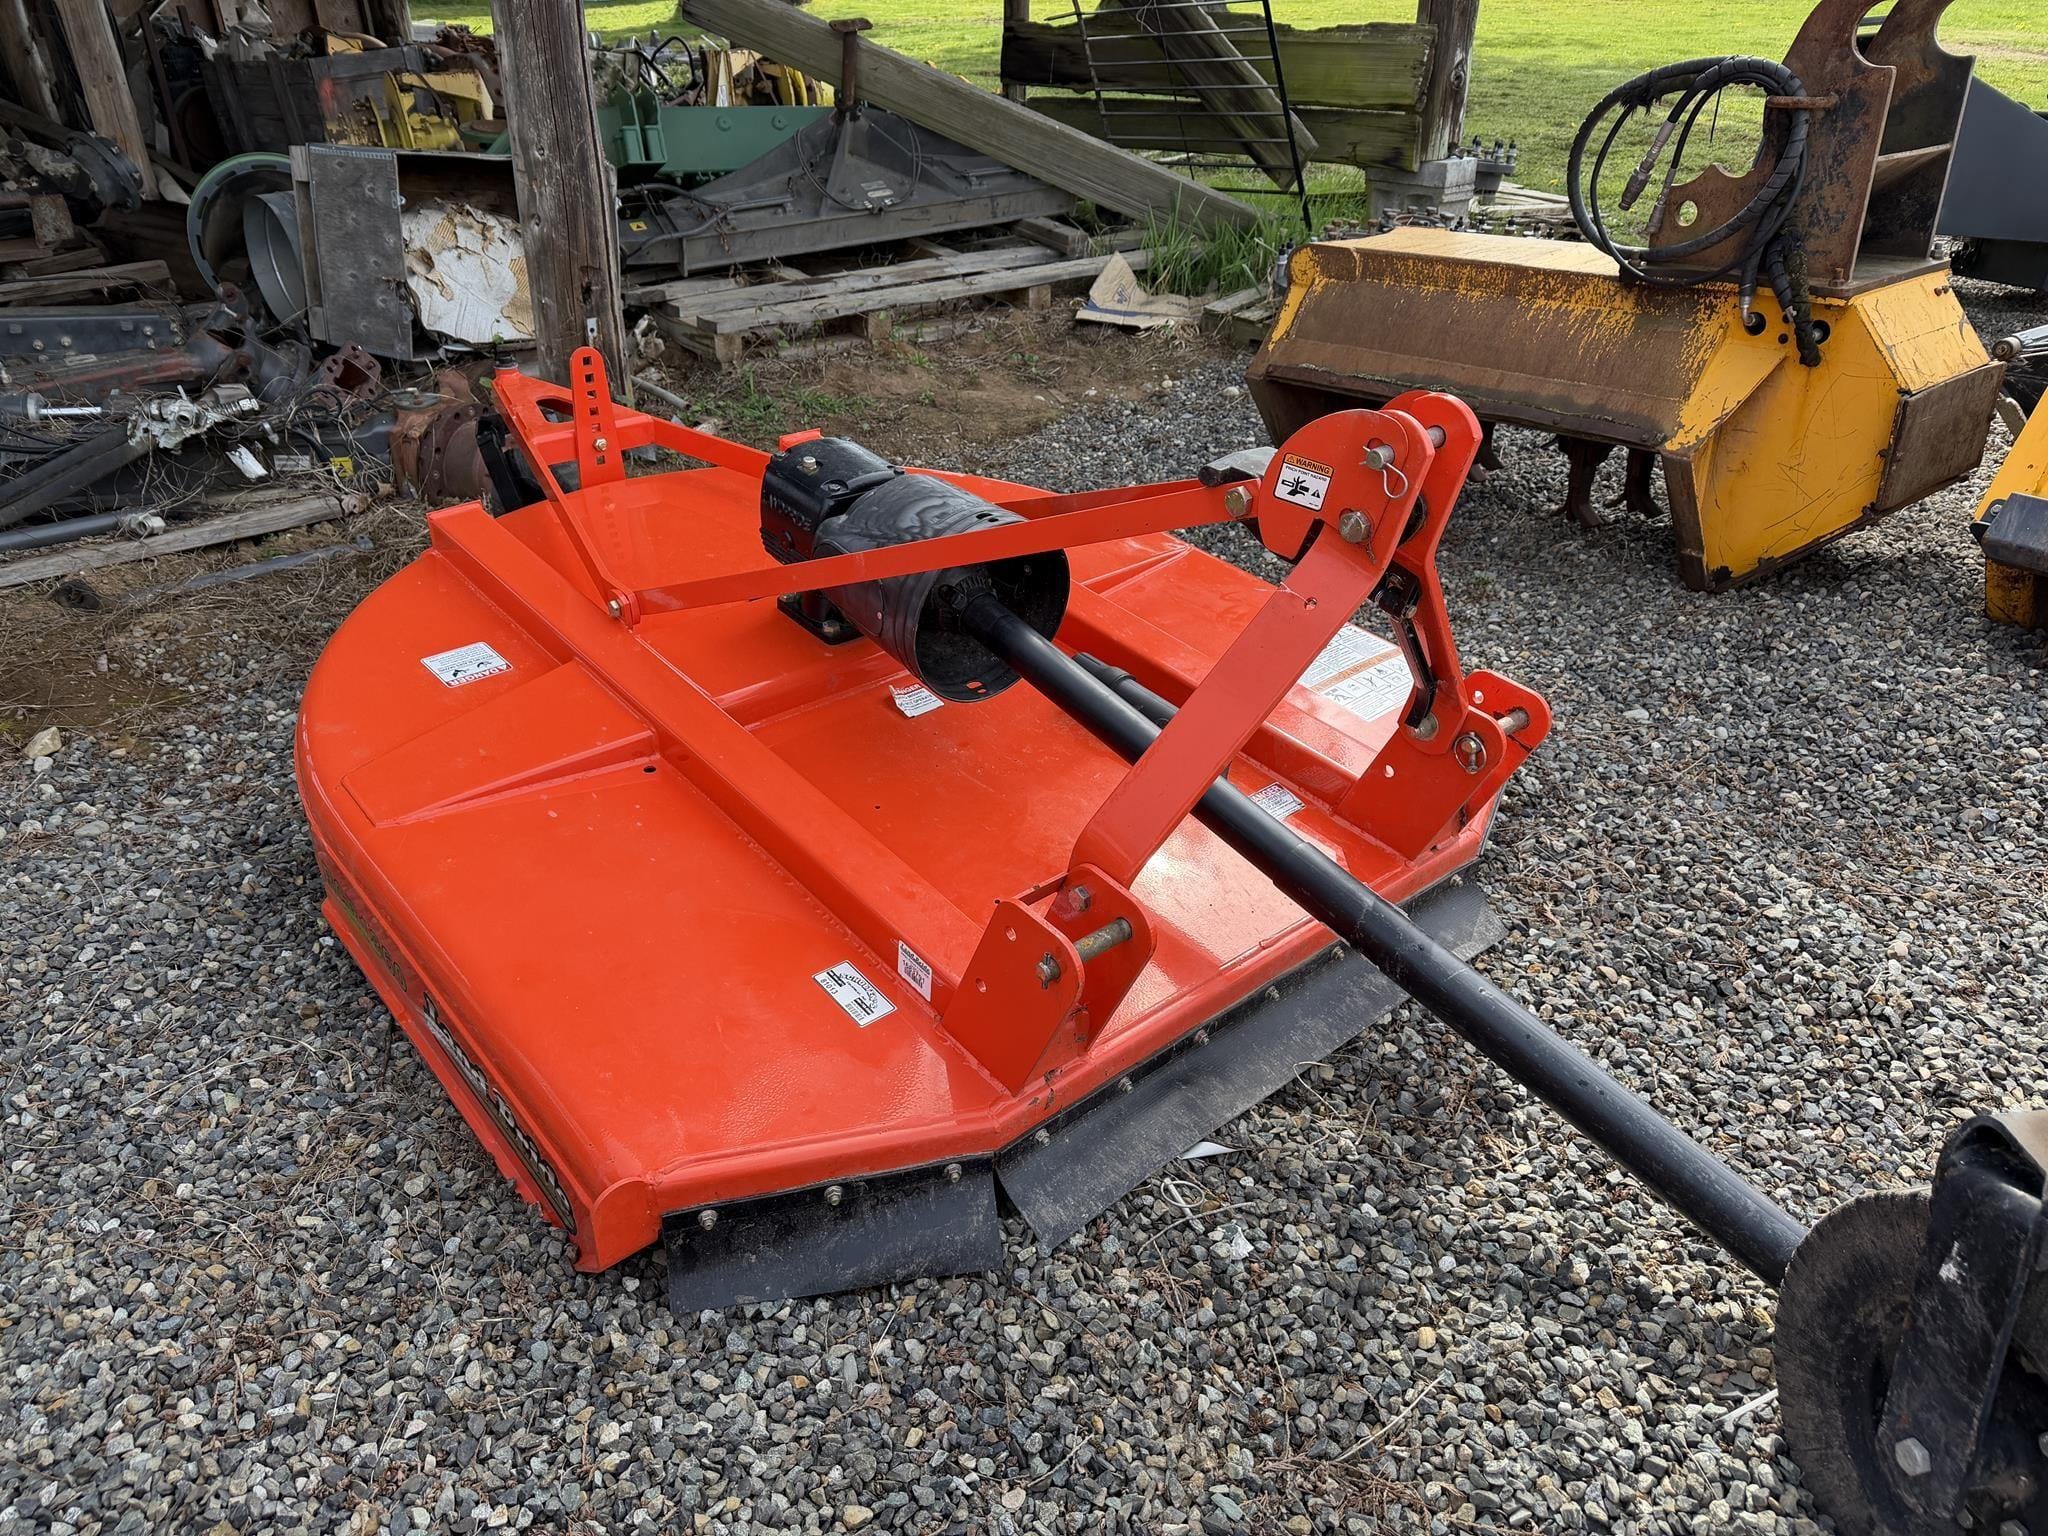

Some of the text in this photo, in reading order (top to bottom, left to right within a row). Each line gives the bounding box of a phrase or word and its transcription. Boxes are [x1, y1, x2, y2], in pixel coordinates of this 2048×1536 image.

[1296, 458, 1329, 474] WARNING
[1311, 473, 1328, 481] HAZARD
[449, 668, 499, 685] DANGER
[1251, 785, 1281, 802] ANGER
[424, 992, 574, 1217] Land Pride
